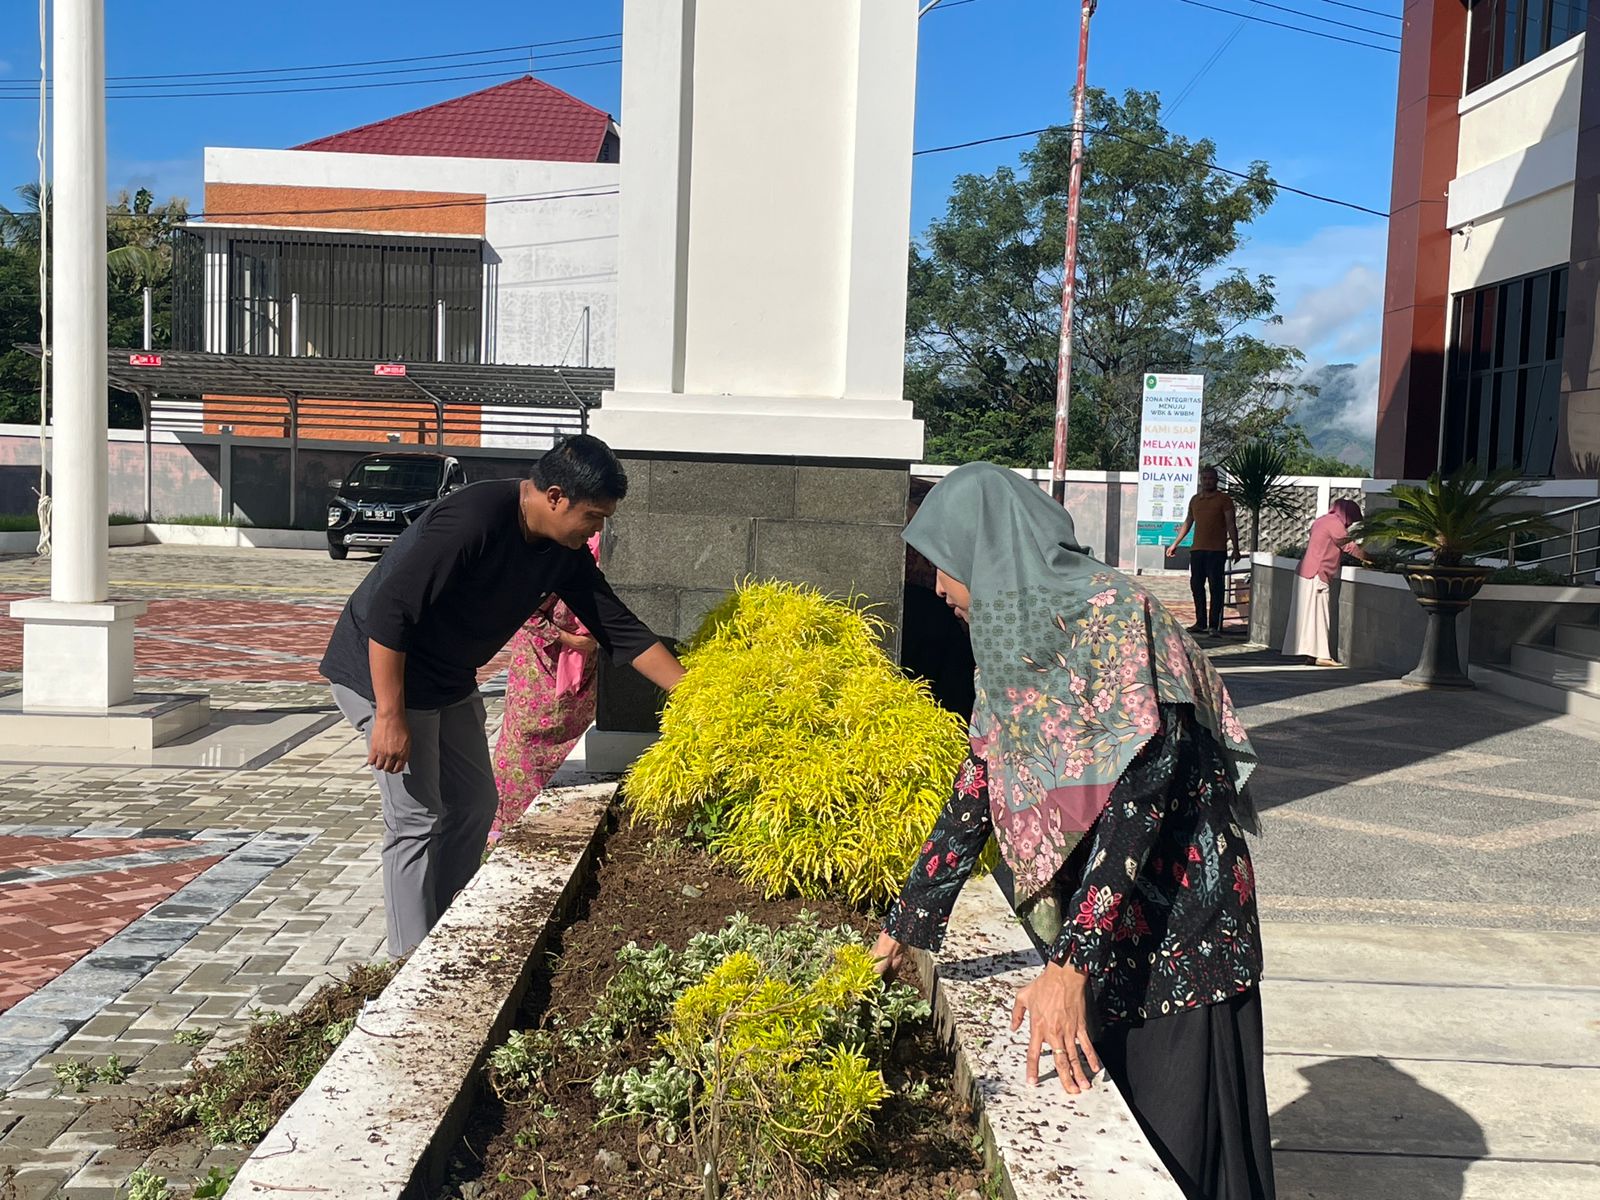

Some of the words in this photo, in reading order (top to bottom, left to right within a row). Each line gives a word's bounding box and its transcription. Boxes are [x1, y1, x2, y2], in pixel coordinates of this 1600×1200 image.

[1145, 425, 1170, 433] KAMI
[1172, 426, 1196, 434] SIAP
[1143, 440, 1196, 450] MELAYANI
[1143, 455, 1193, 467] BUKAN
[1142, 472, 1193, 482] DILAYANI
